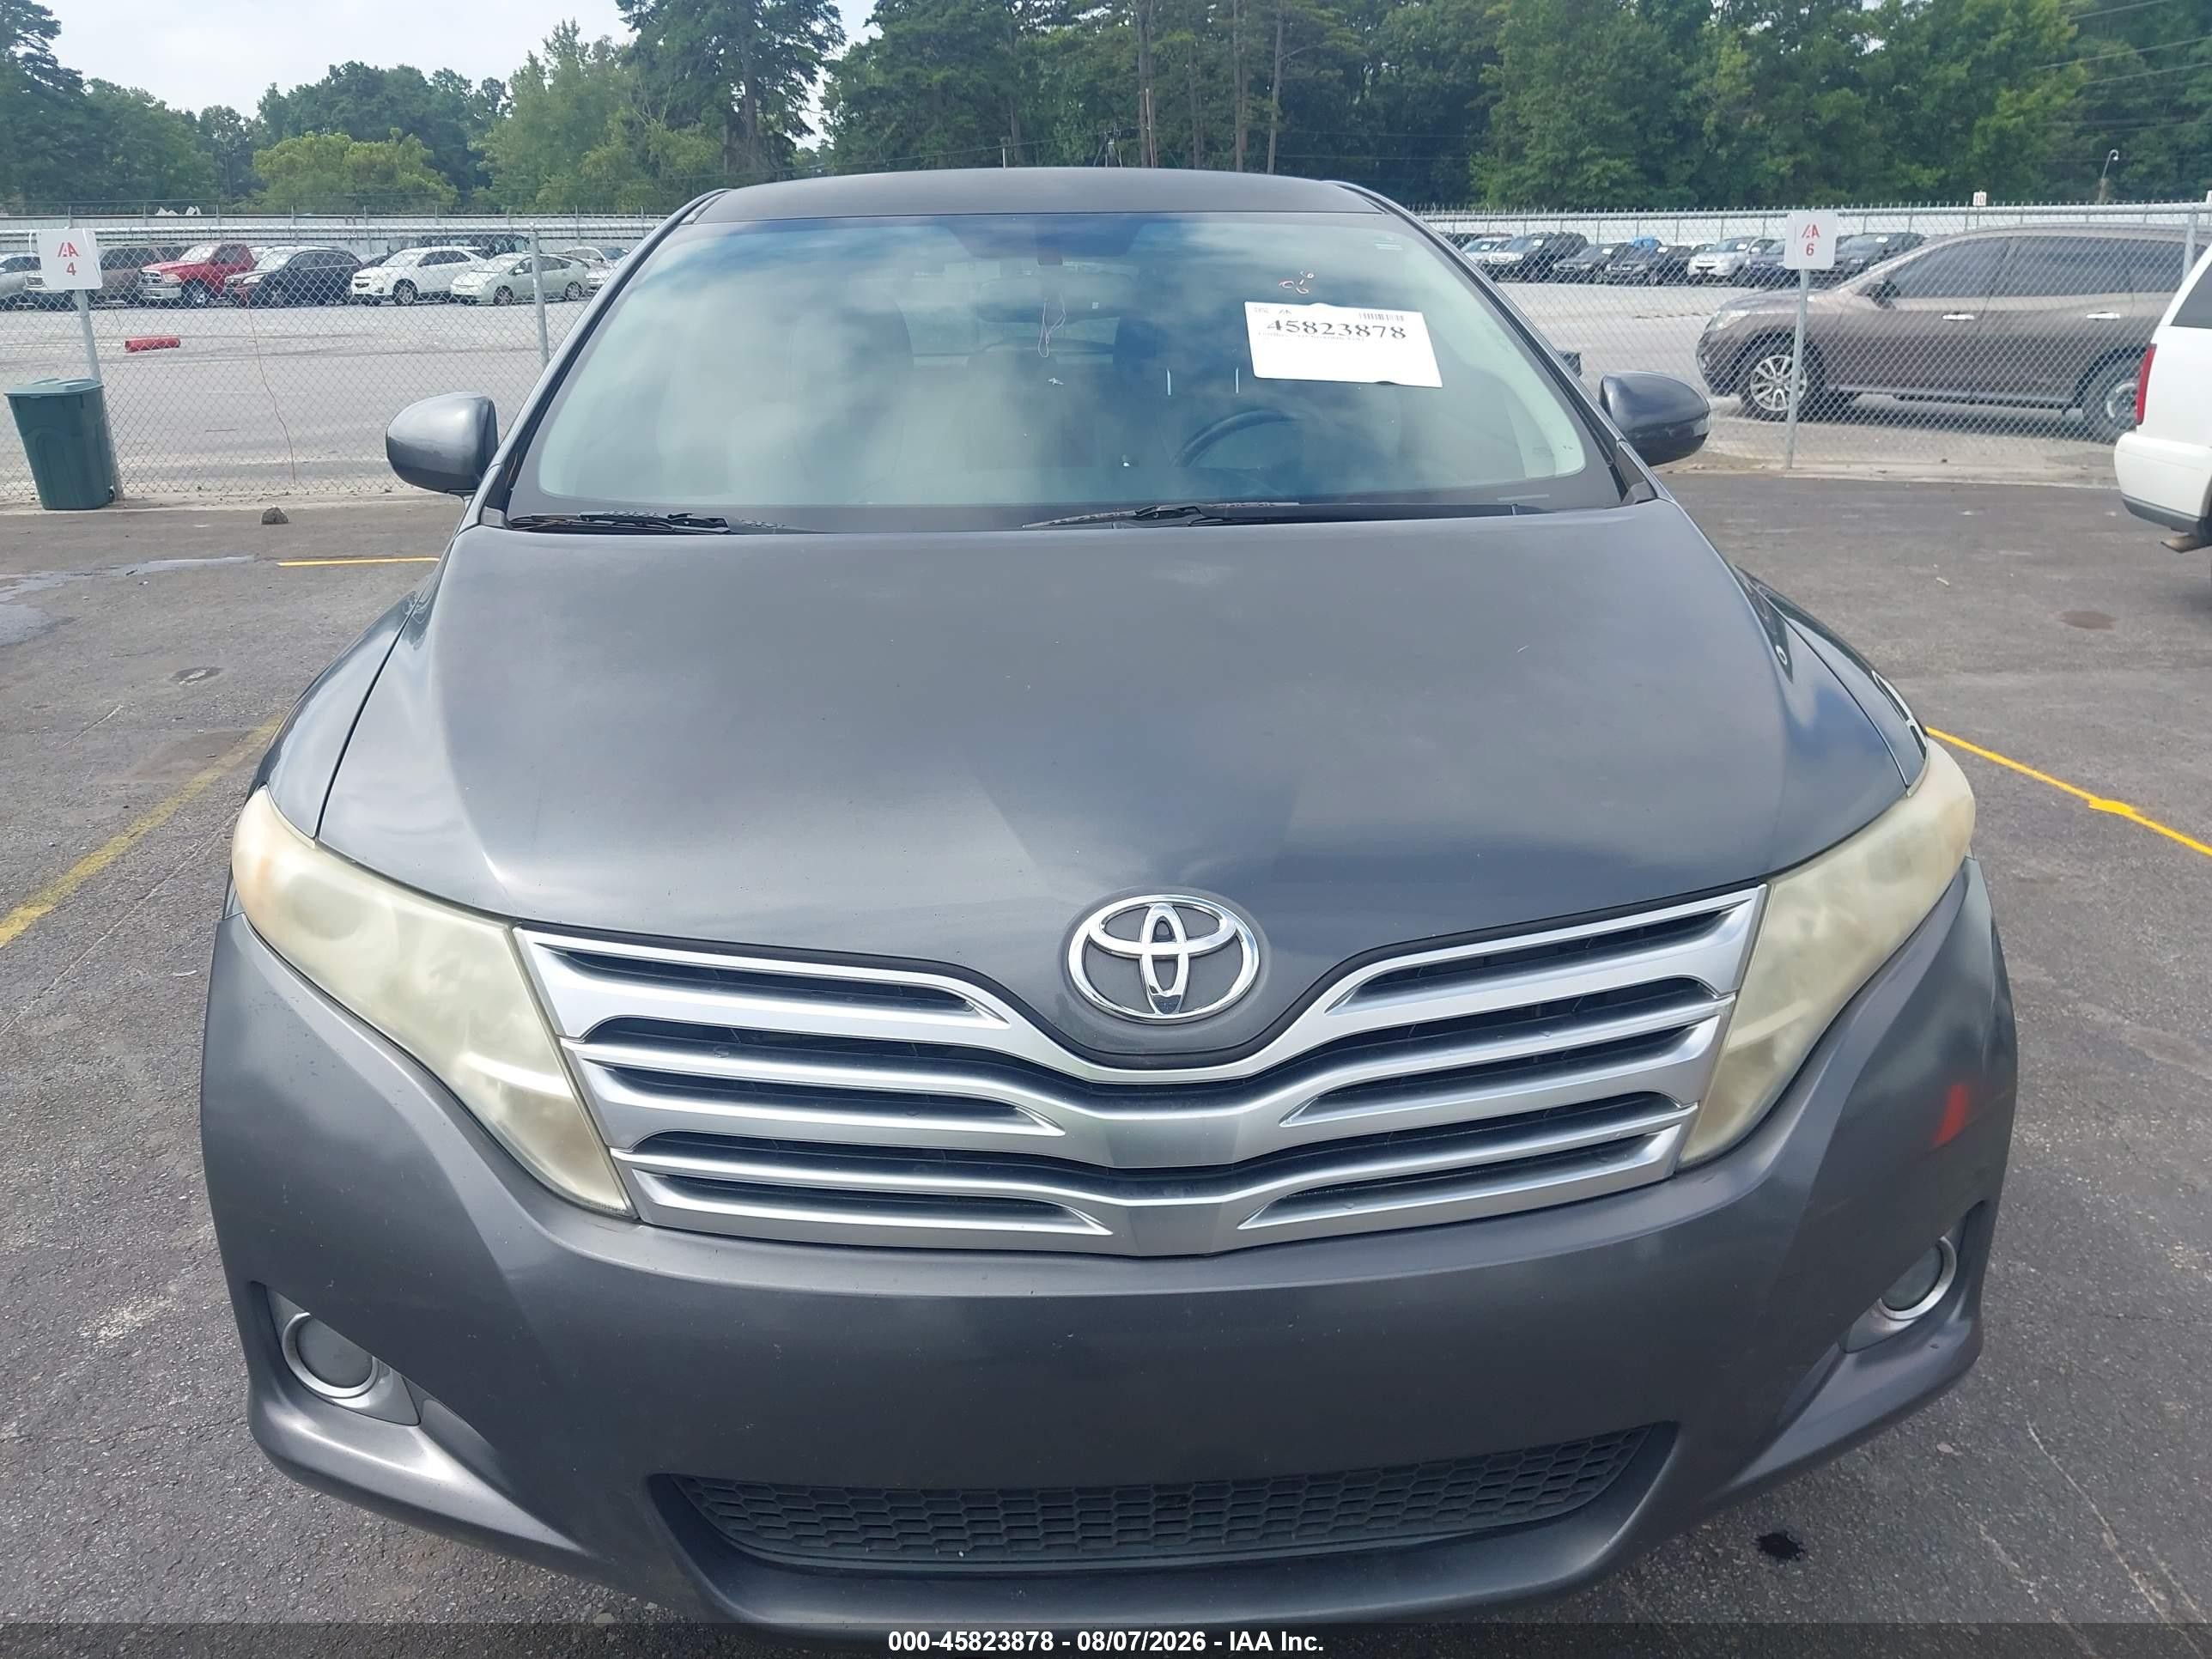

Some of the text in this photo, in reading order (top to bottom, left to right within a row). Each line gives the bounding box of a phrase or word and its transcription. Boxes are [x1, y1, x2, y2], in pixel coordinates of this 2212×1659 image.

[1806, 243, 1814, 256] 6
[66, 262, 76, 276] 4
[1267, 319, 1407, 340] 45823878
